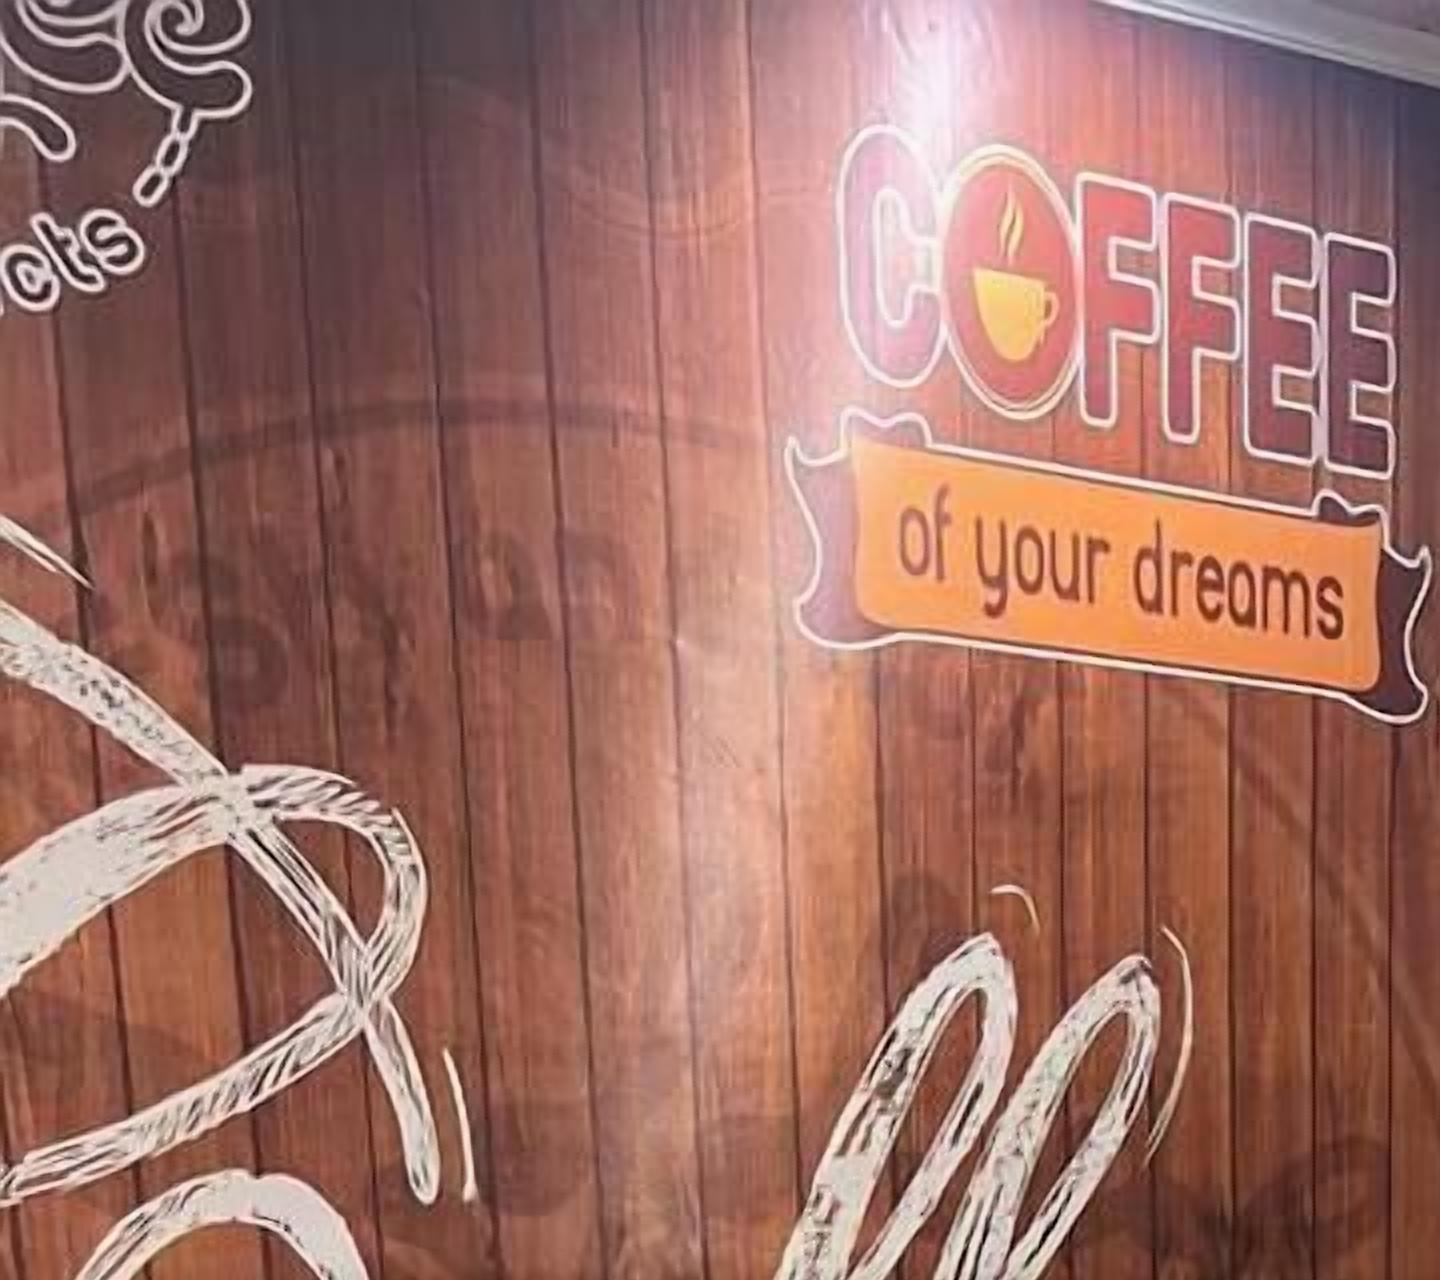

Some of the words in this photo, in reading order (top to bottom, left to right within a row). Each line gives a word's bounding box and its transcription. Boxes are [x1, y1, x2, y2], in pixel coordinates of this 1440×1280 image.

[0, 208, 150, 312] cts
[836, 123, 1397, 480] COFFEE
[899, 484, 953, 580] of
[974, 517, 1110, 618] your
[1132, 519, 1346, 641] dreams
